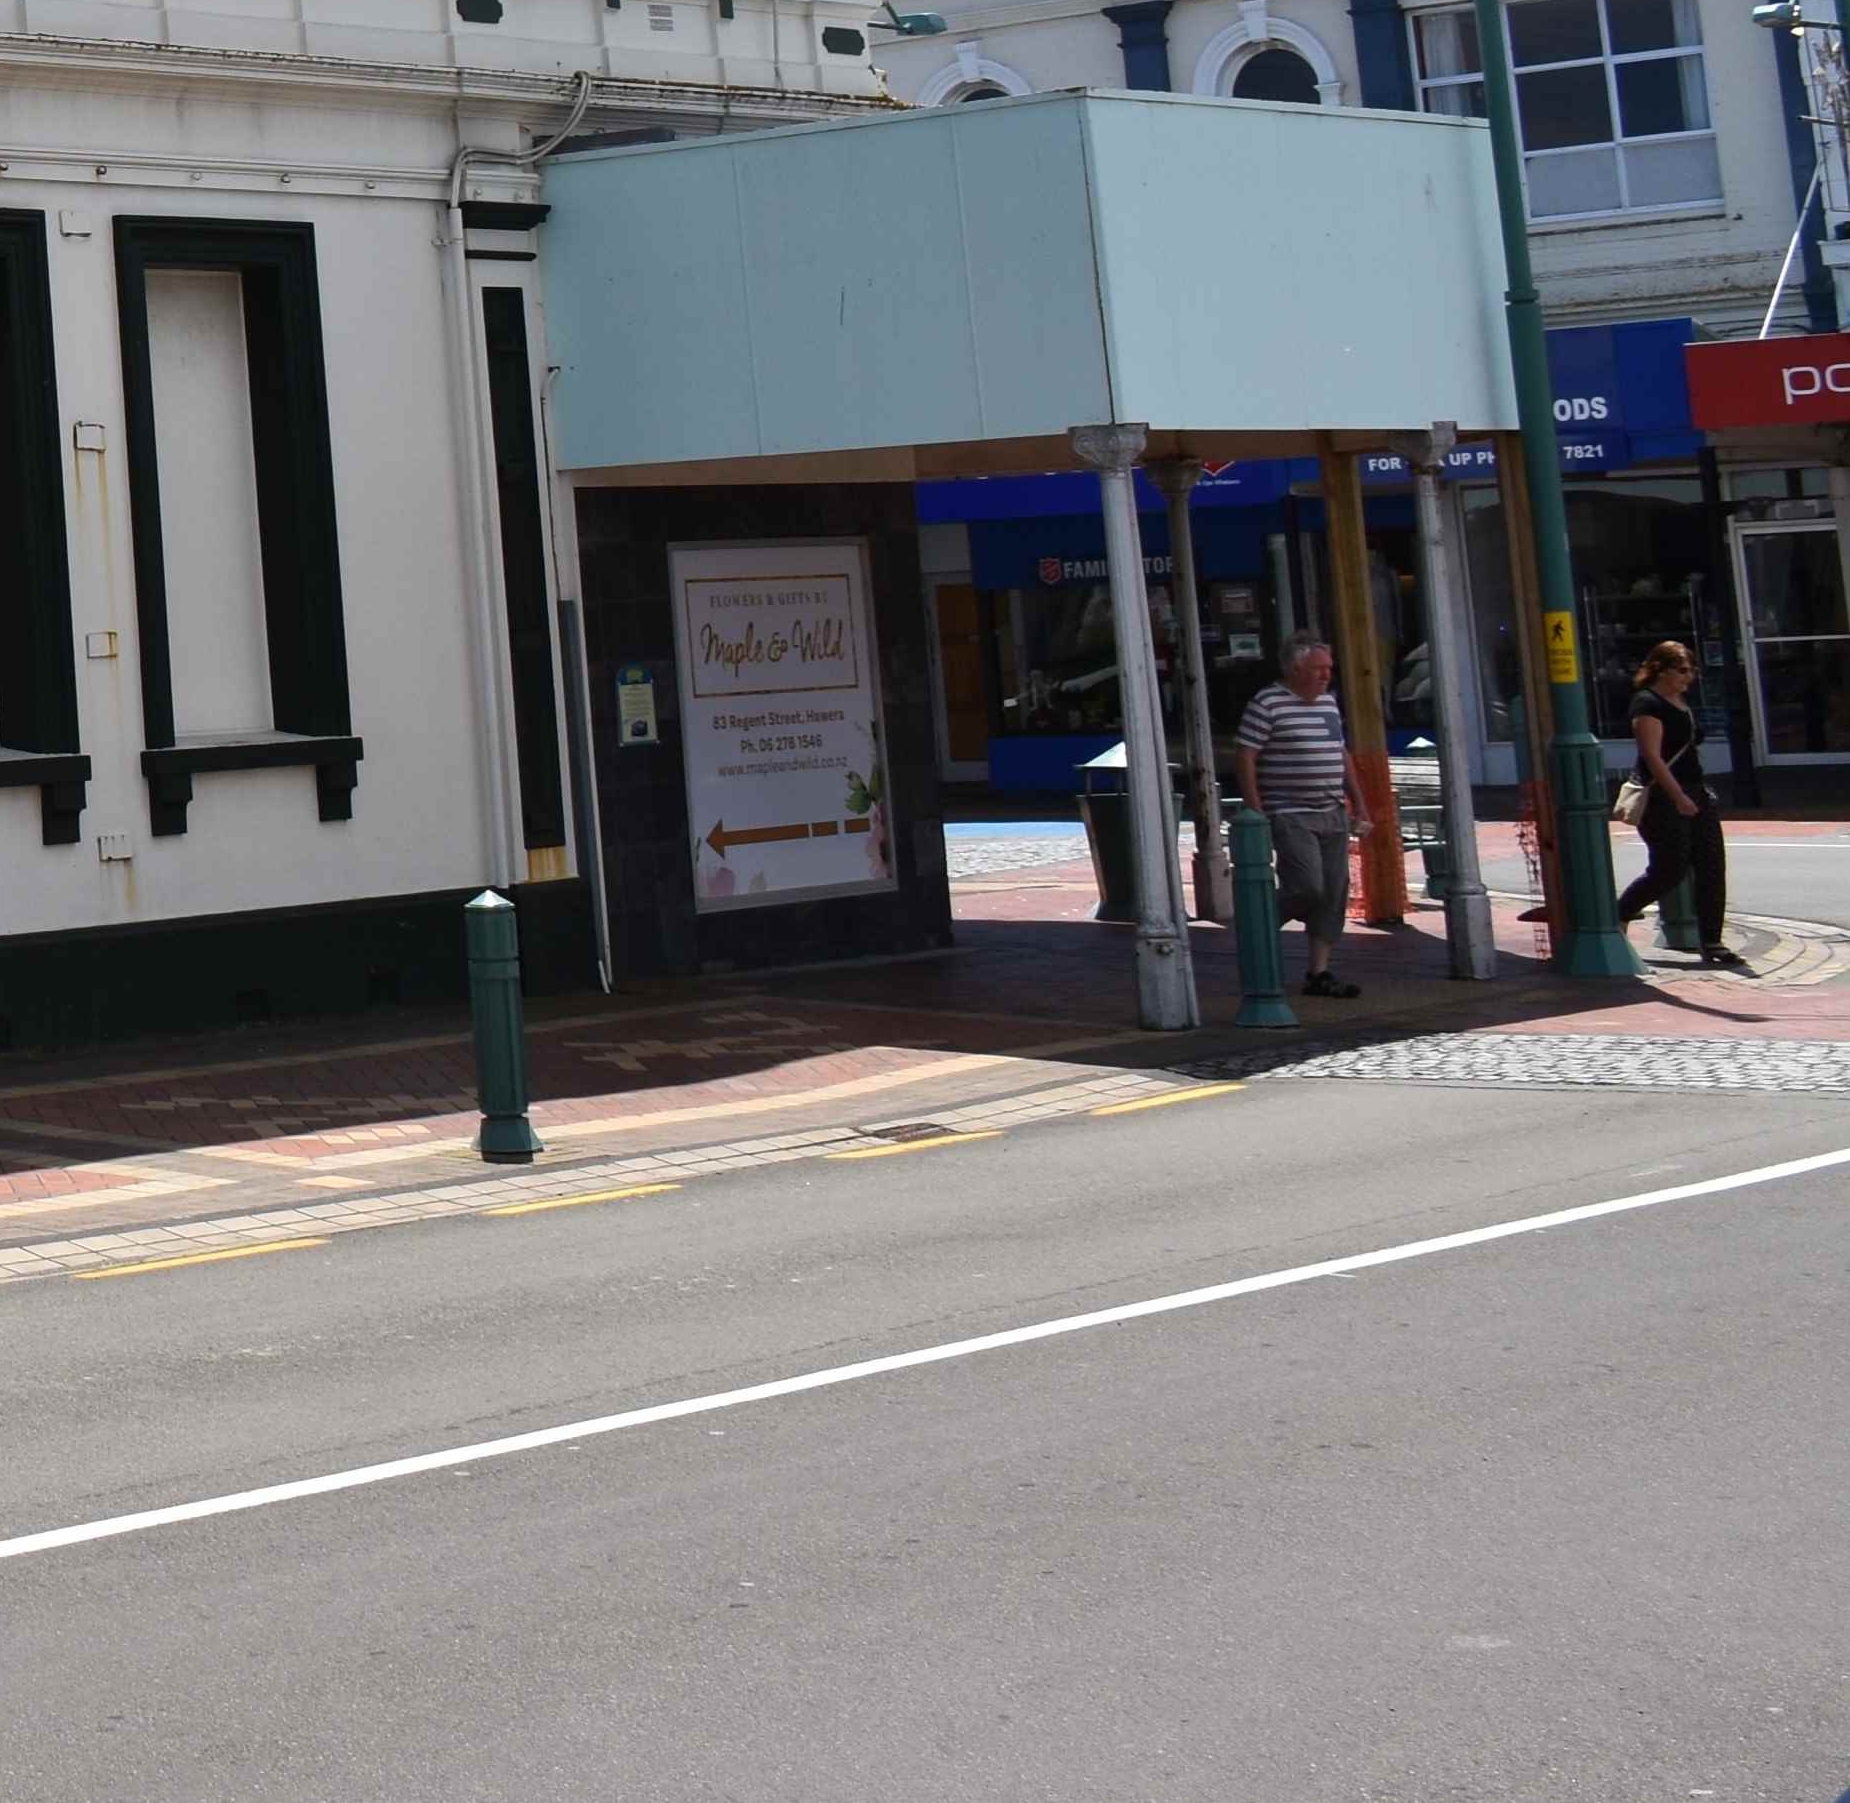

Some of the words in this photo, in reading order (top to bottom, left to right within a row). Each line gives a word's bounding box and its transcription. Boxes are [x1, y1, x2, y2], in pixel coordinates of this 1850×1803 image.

[1553, 397, 1608, 421] ODS
[1368, 457, 1402, 472] FOR
[1449, 452, 1472, 466] UP
[1563, 445, 1604, 460] 7821
[1063, 559, 1107, 579] FAMI
[700, 621, 765, 677] Maple
[767, 632, 789, 662] &
[791, 617, 844, 663] Wild
[730, 714, 766, 731] Regent
